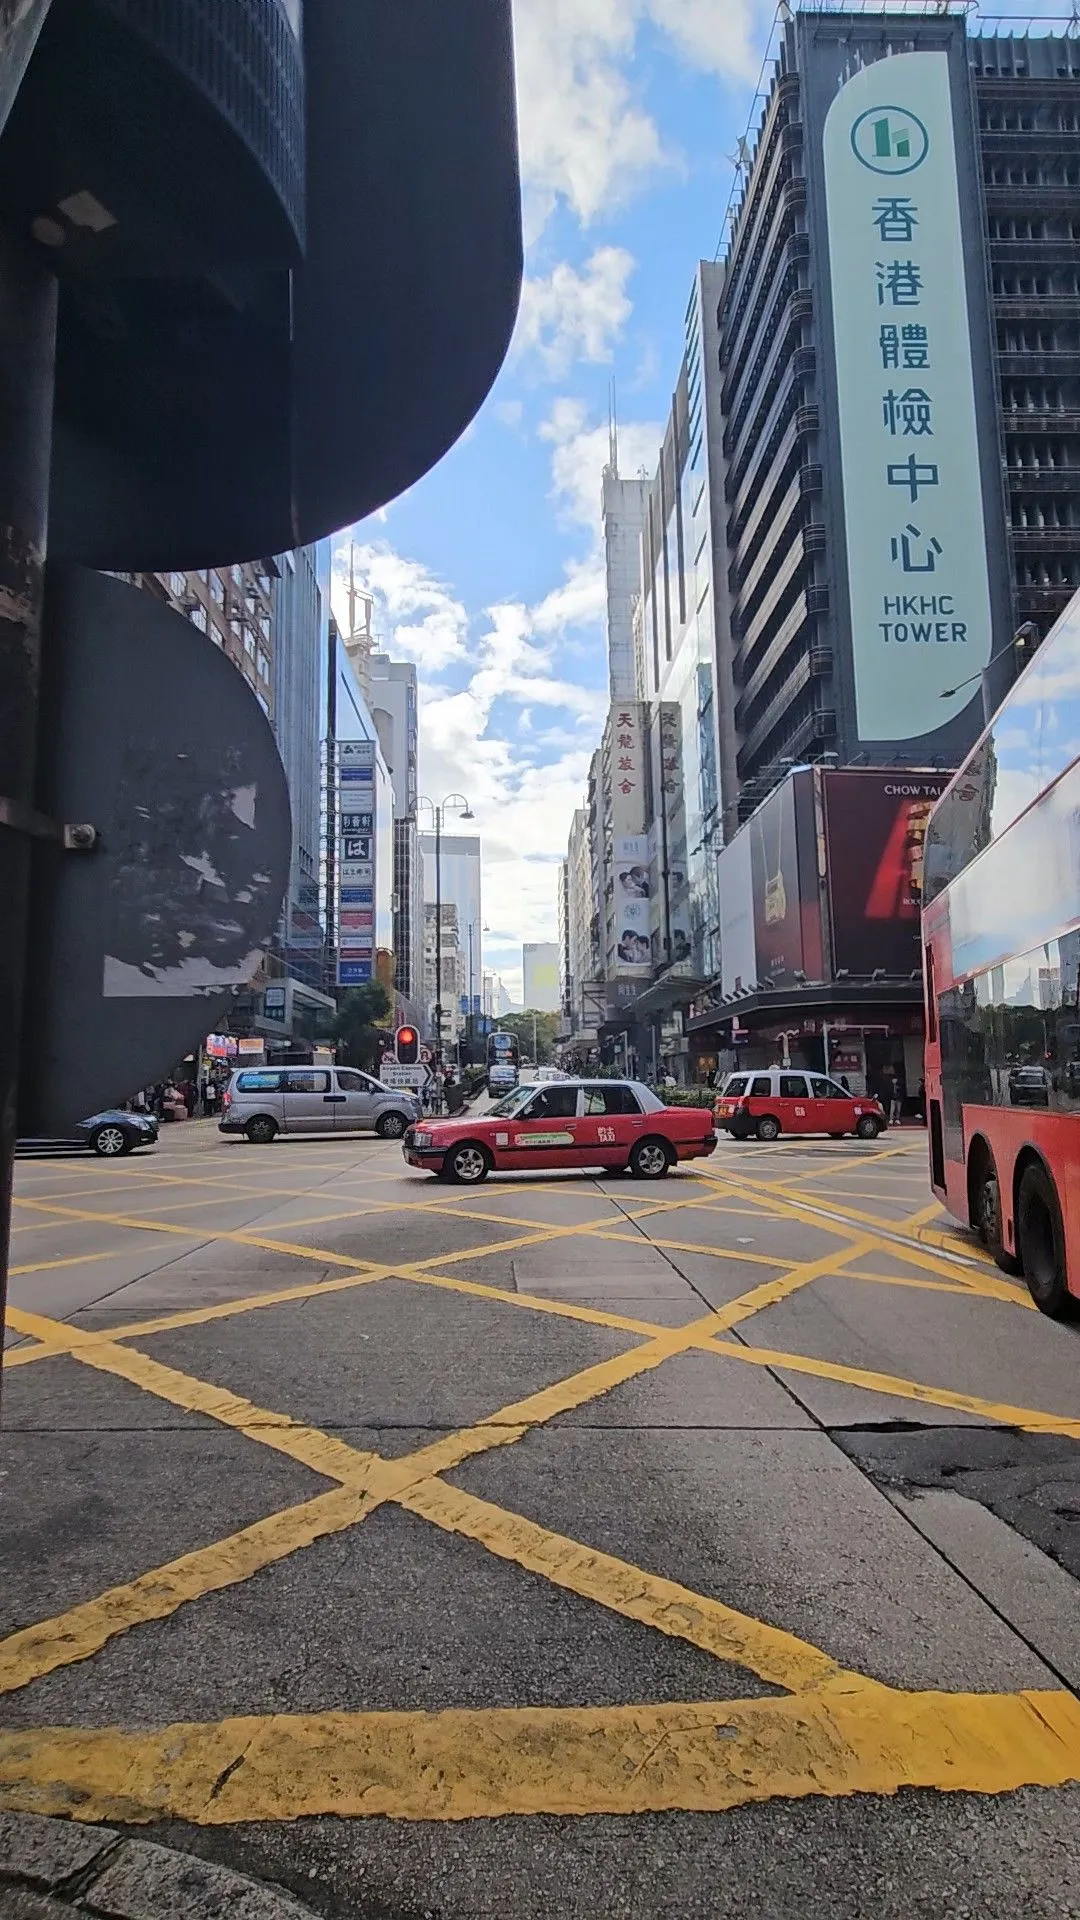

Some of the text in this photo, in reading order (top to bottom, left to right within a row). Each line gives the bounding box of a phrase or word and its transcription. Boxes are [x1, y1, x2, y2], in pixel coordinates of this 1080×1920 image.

[871, 196, 944, 573] 香港體檢中心
[883, 595, 955, 616] HKHC
[878, 622, 967, 642] TOWER
[884, 784, 941, 796] CHOW TAI
